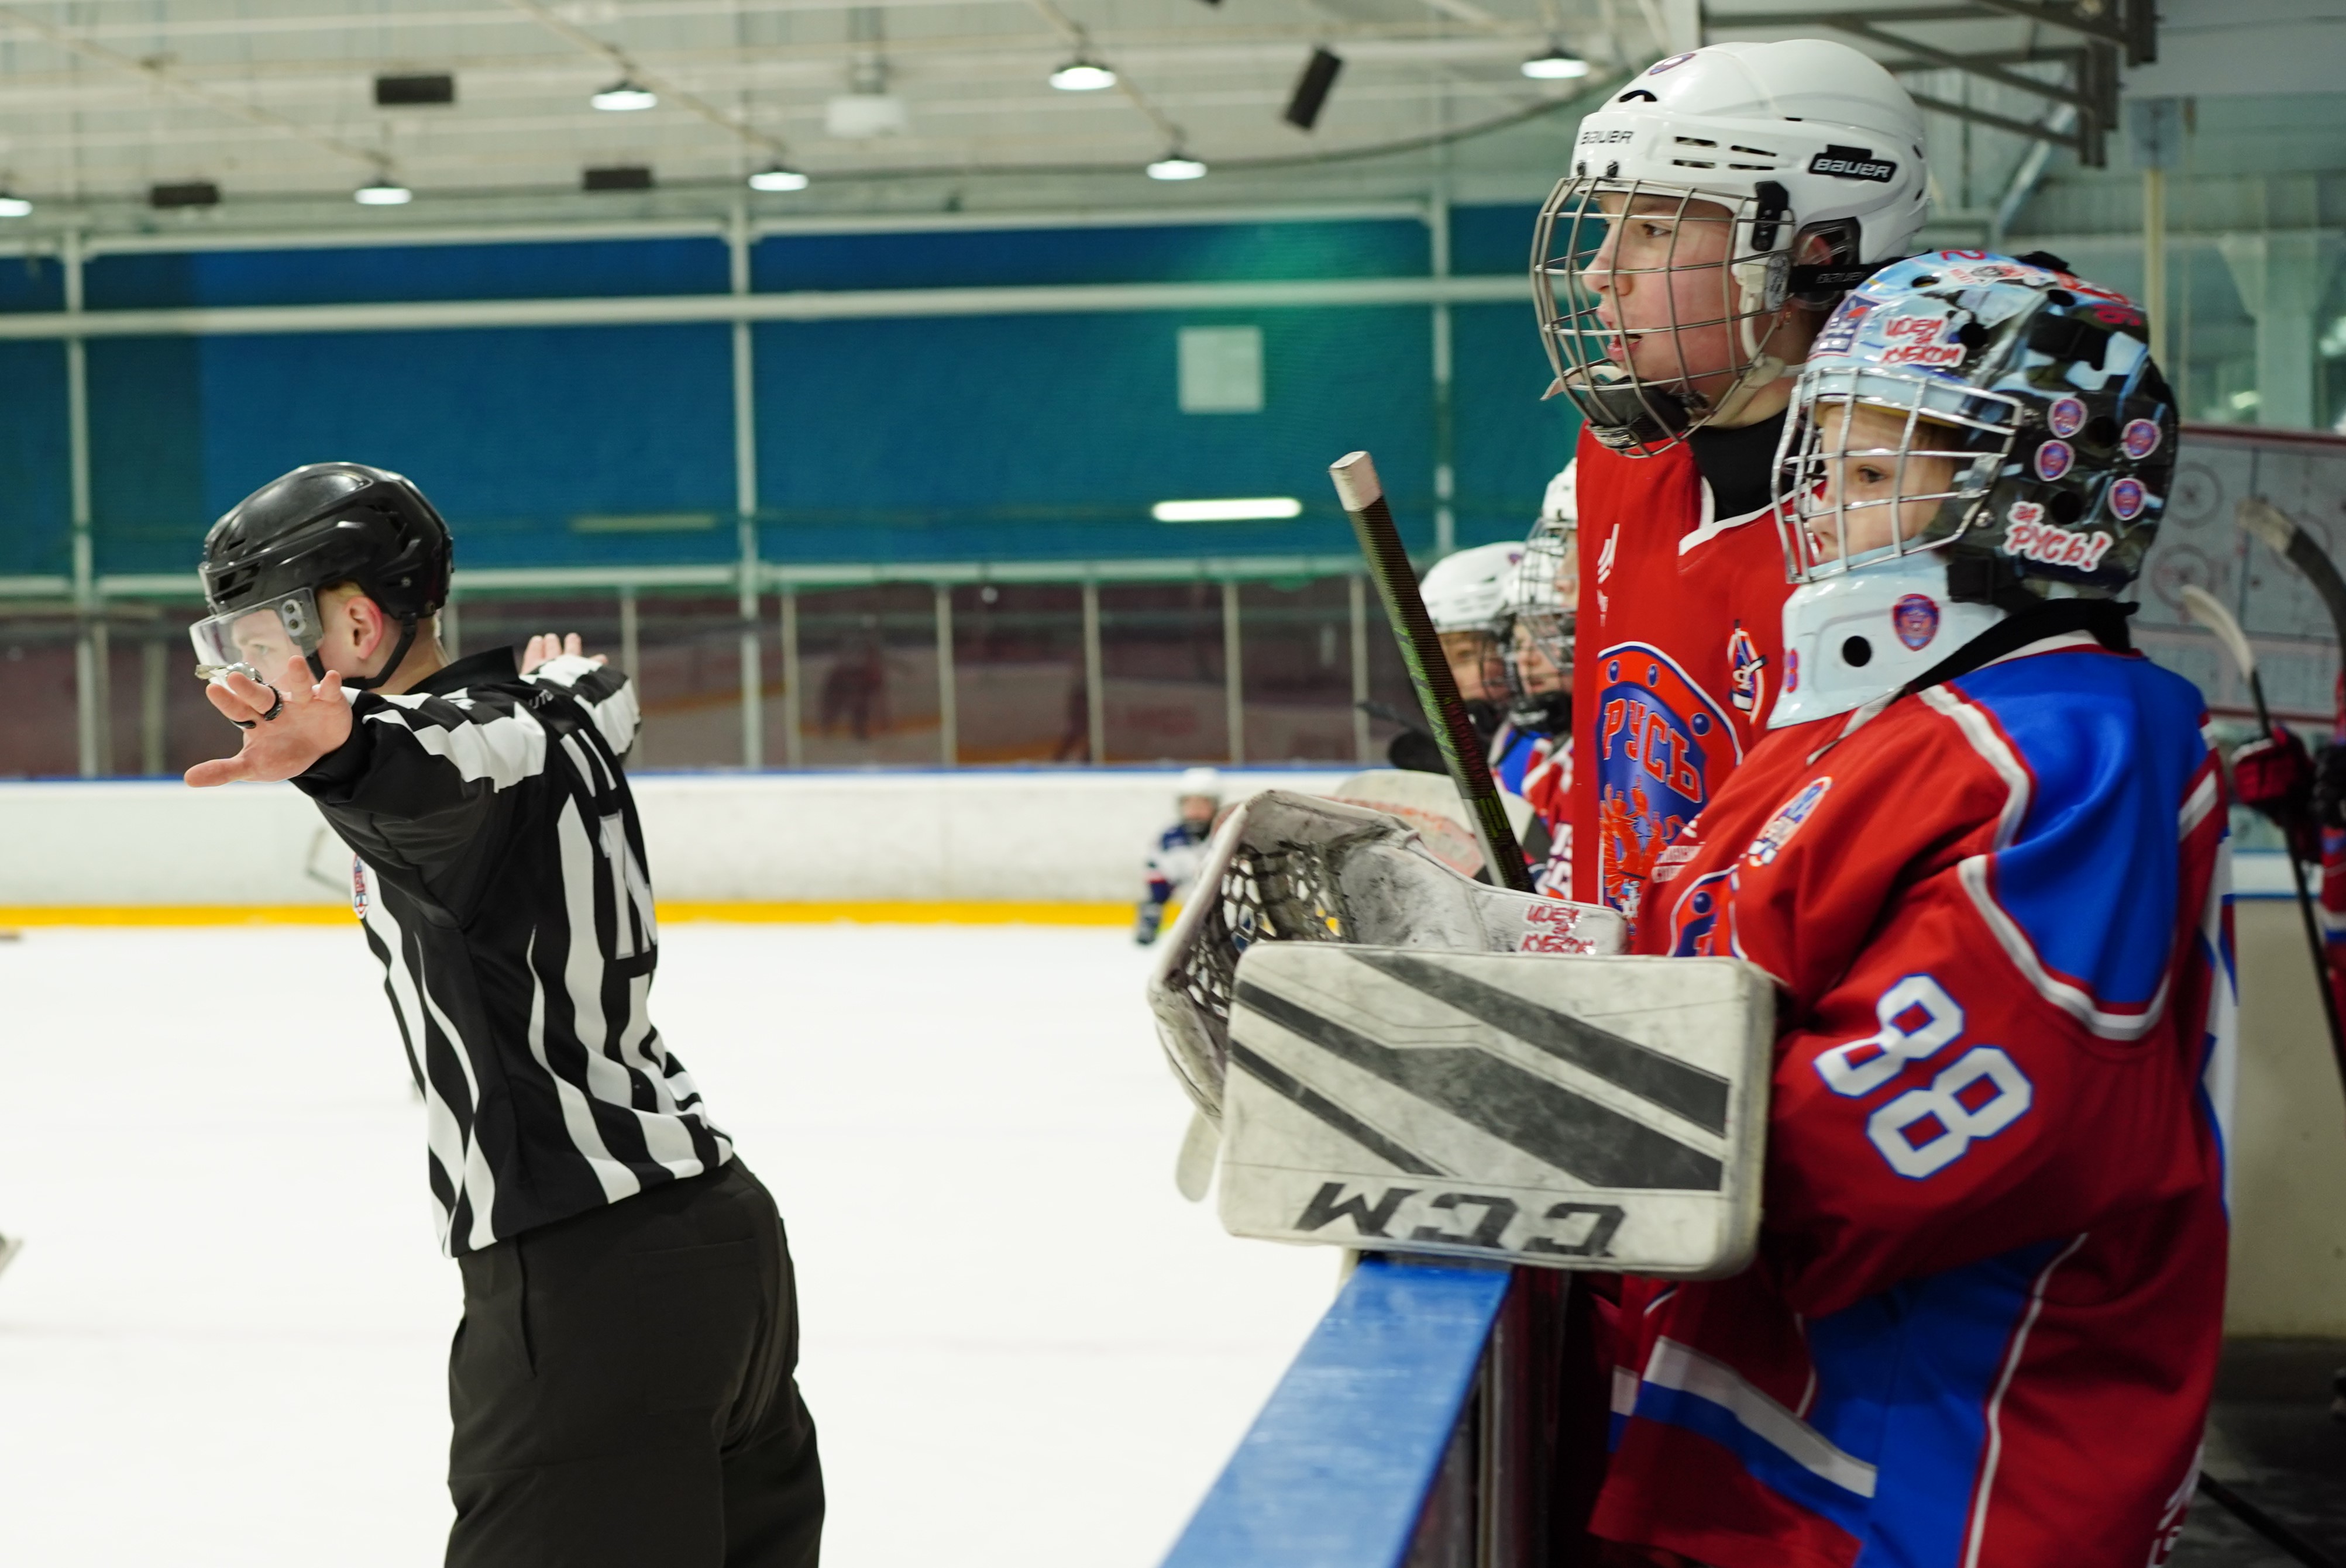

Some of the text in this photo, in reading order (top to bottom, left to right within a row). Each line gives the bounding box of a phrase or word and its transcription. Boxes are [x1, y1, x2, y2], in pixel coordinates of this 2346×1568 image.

[1581, 131, 1633, 144] BAUER
[1813, 158, 1891, 178] BAUER
[1602, 698, 1702, 803] РУСЬ
[1813, 972, 2034, 1181] 88
[1292, 1181, 1626, 1258] CCM
